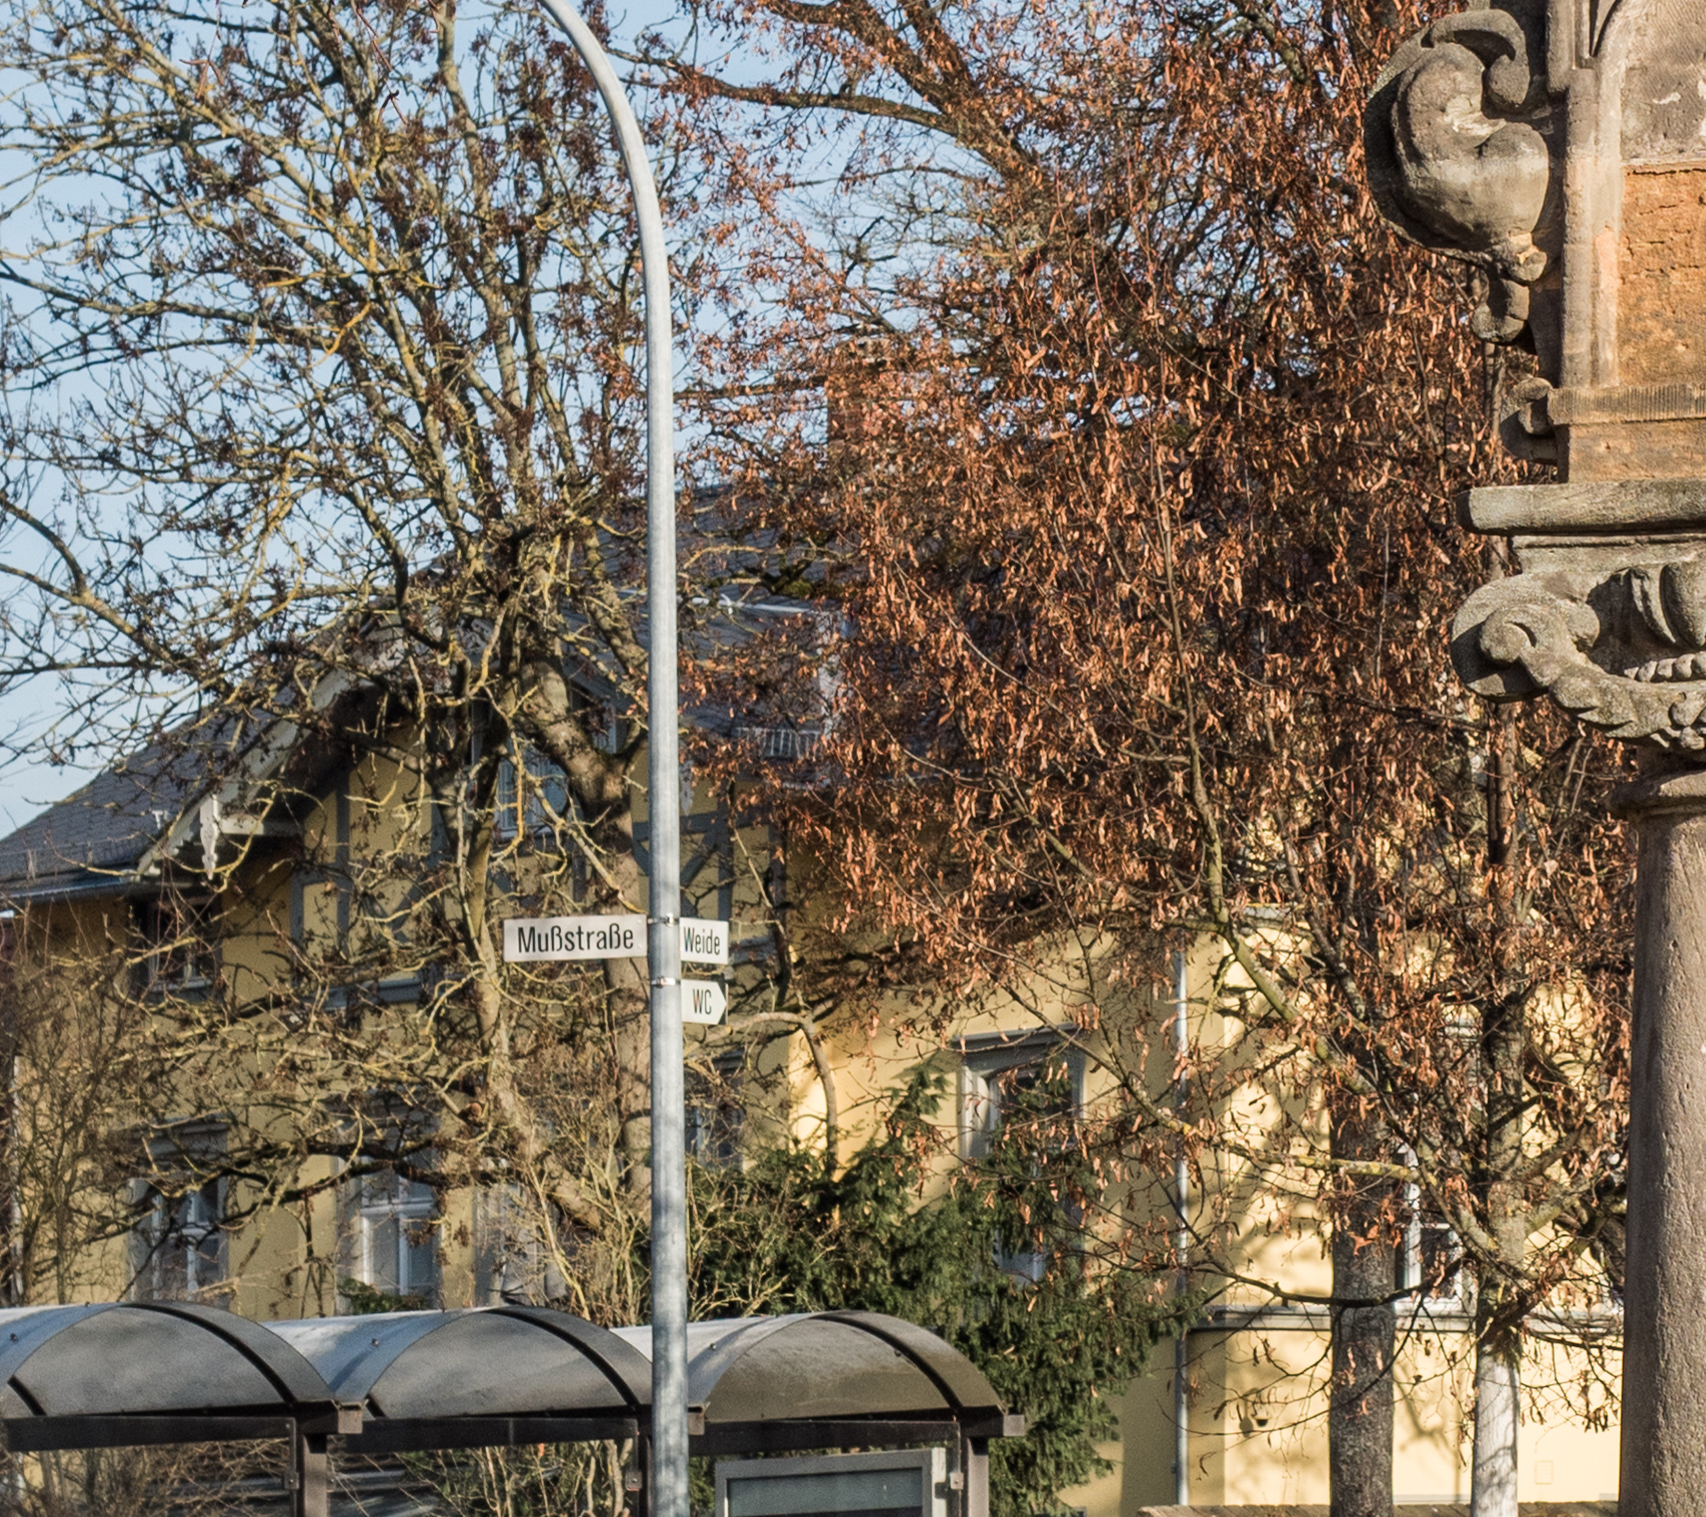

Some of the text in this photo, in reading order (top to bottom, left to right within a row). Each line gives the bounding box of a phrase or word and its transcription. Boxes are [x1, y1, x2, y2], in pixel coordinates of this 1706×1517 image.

[517, 923, 634, 954] Mußstraße
[683, 926, 721, 956] Weide
[692, 988, 712, 1015] WC
